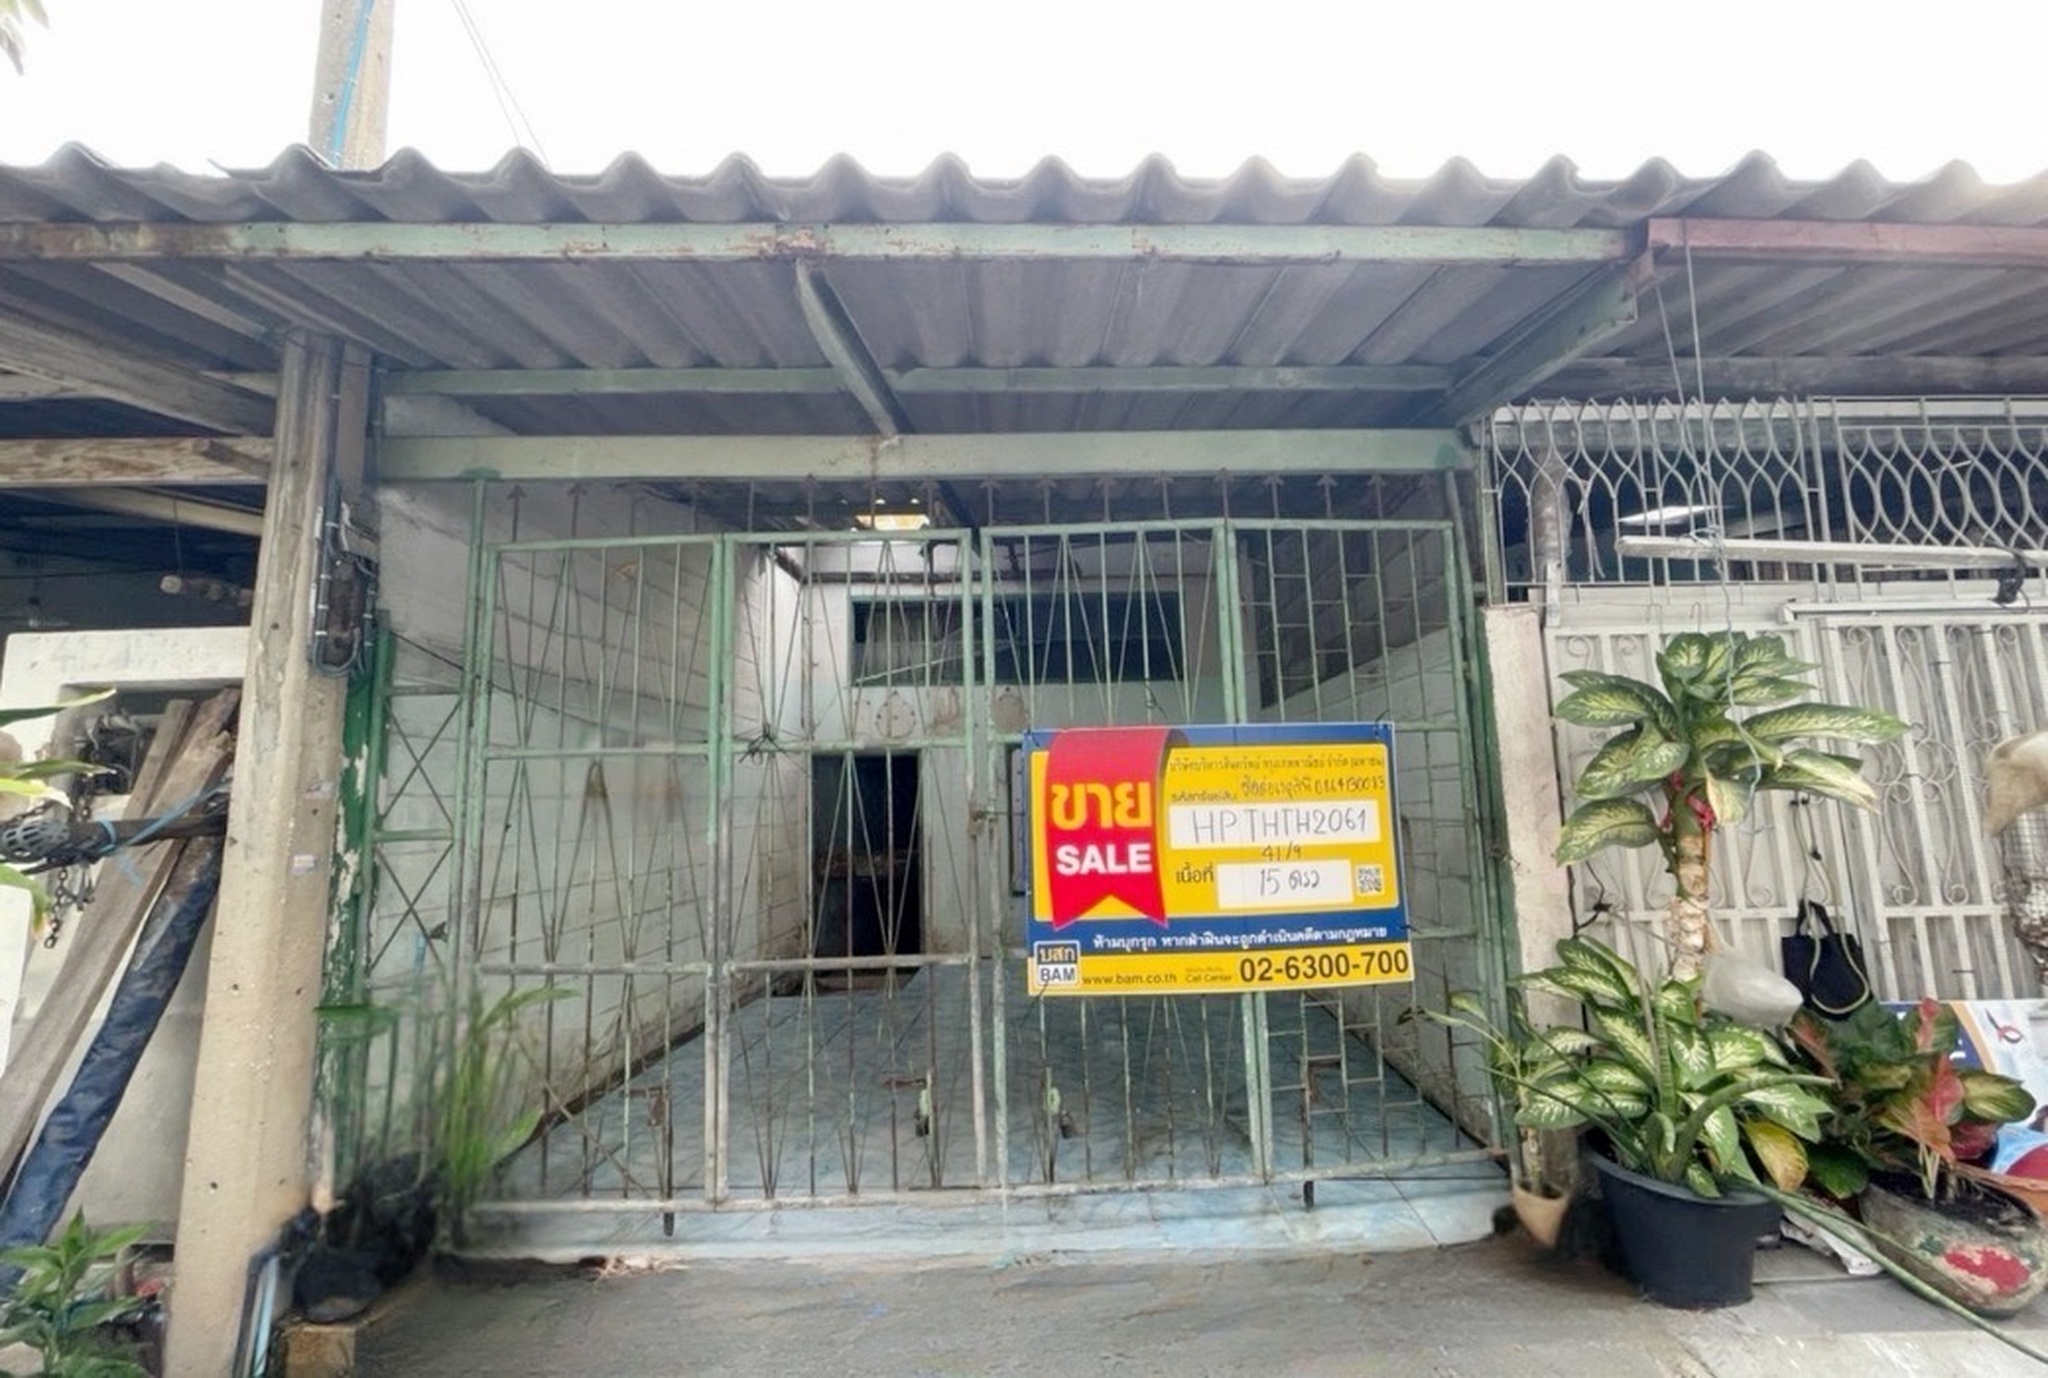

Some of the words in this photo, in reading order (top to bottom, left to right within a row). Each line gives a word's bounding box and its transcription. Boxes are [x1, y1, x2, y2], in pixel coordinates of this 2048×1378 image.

[1051, 781, 1152, 830] ขาย
[1056, 842, 1153, 876] SALE
[1176, 862, 1214, 883] เนื้อที่
[1260, 869, 1281, 897] 15
[1093, 933, 1157, 952] ห้ามบุกรุก
[1039, 946, 1076, 963] บสก
[1040, 967, 1076, 983] BAM
[1240, 949, 1409, 983] 02-6300-700
[1082, 973, 1177, 985] www.bam.co.th
